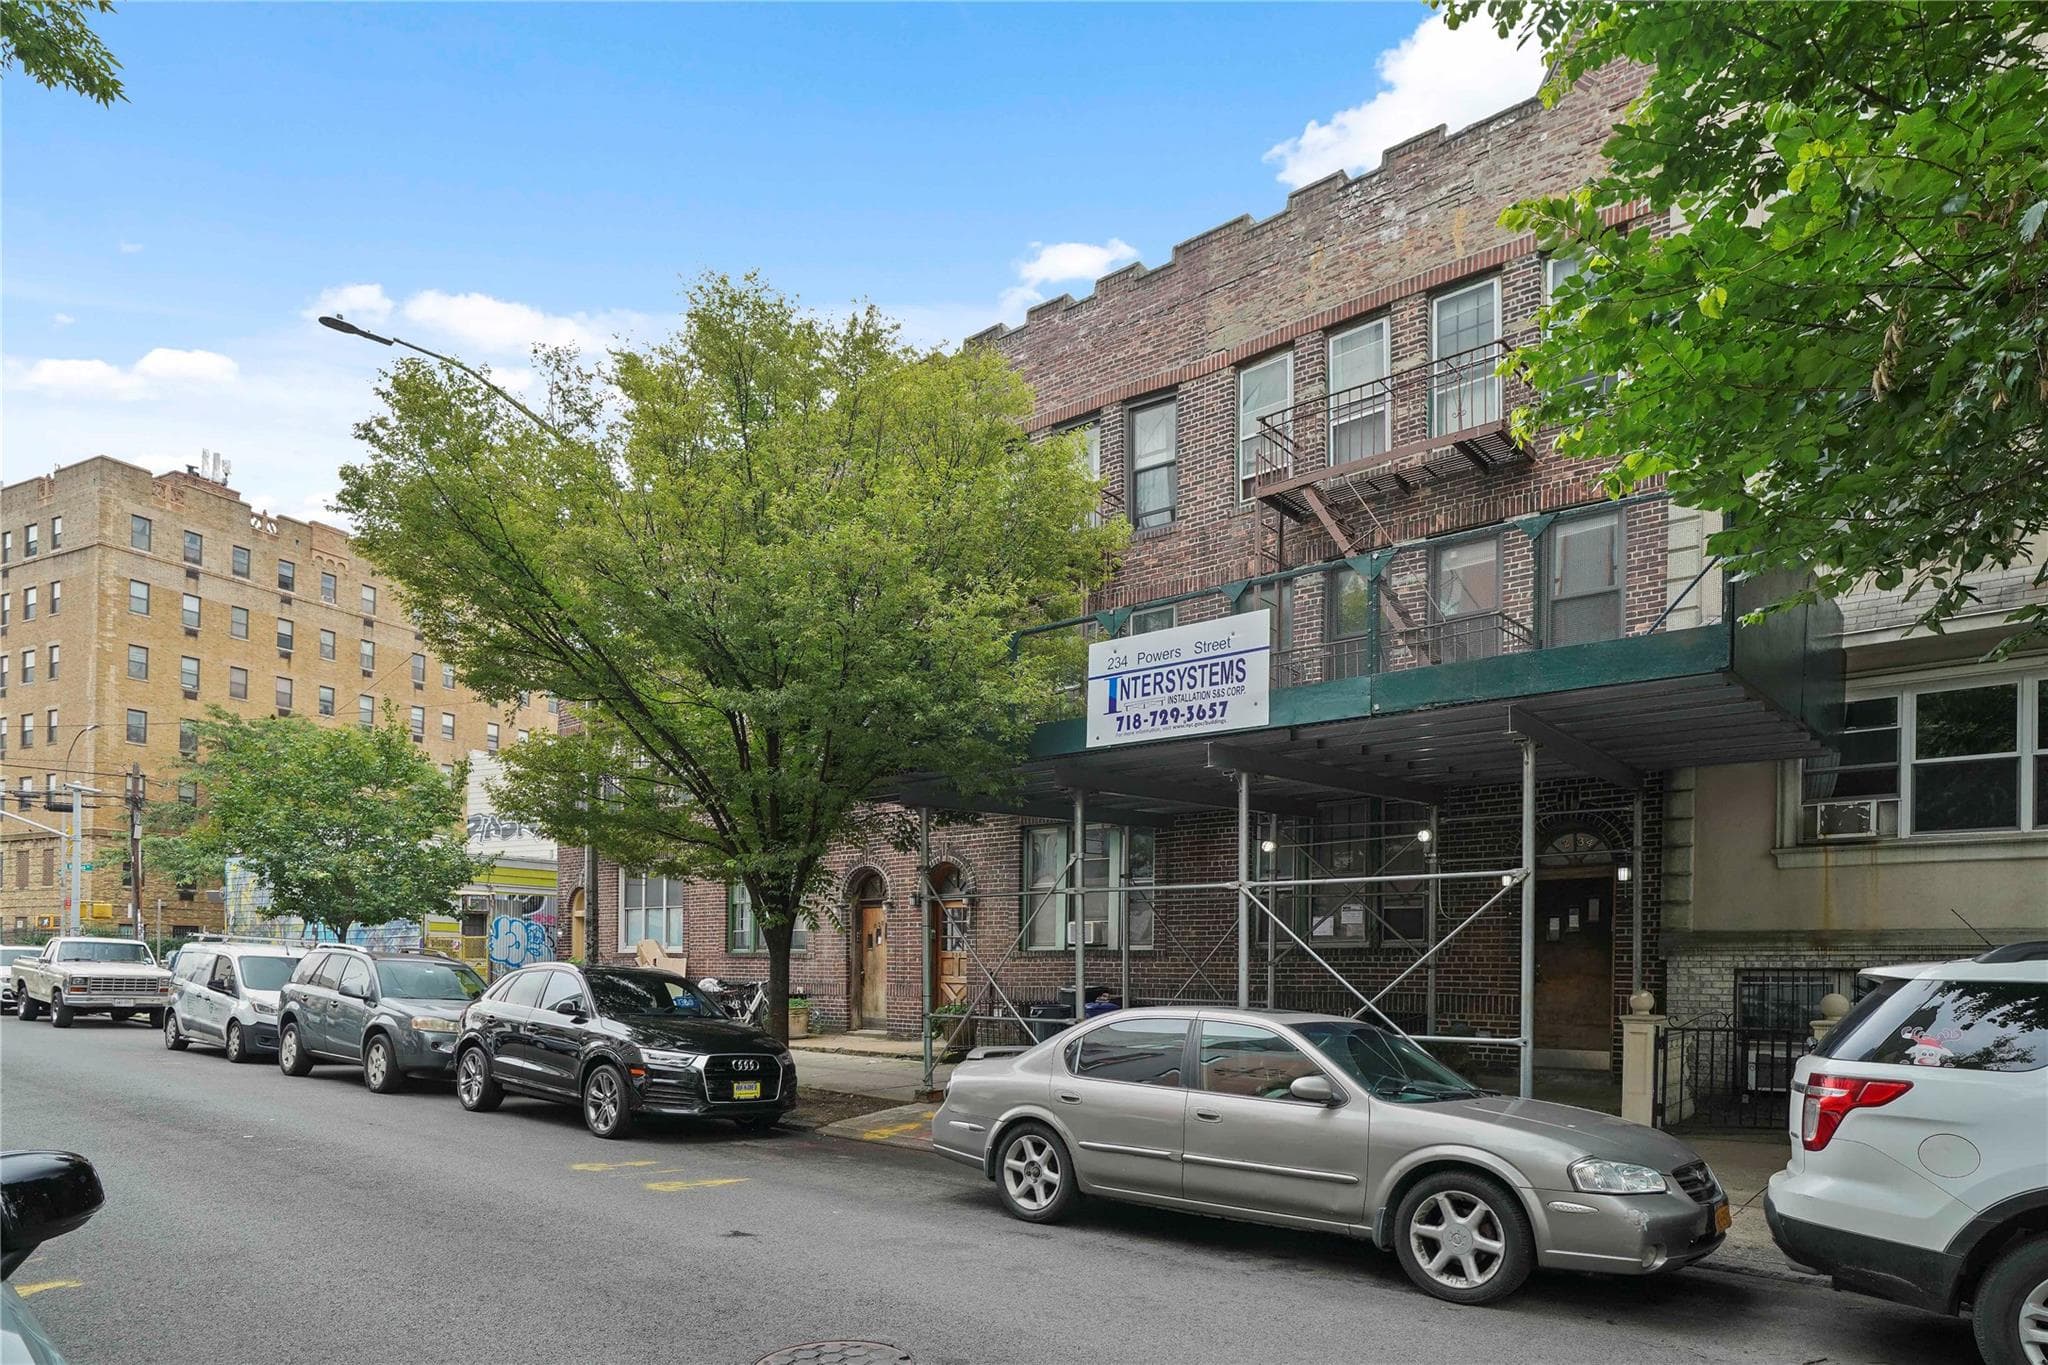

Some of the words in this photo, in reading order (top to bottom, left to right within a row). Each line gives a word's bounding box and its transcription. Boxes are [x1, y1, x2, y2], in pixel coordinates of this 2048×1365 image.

[1107, 655, 1128, 670] 234
[1137, 647, 1182, 665] Powers
[1193, 636, 1231, 655] Street
[1103, 657, 1247, 715] INTERSYSTEMS
[1167, 690, 1211, 705] INSTALLATION
[1212, 687, 1226, 699] S&S
[1226, 685, 1246, 697] CORP.
[1116, 700, 1228, 732] 718-729-3657
